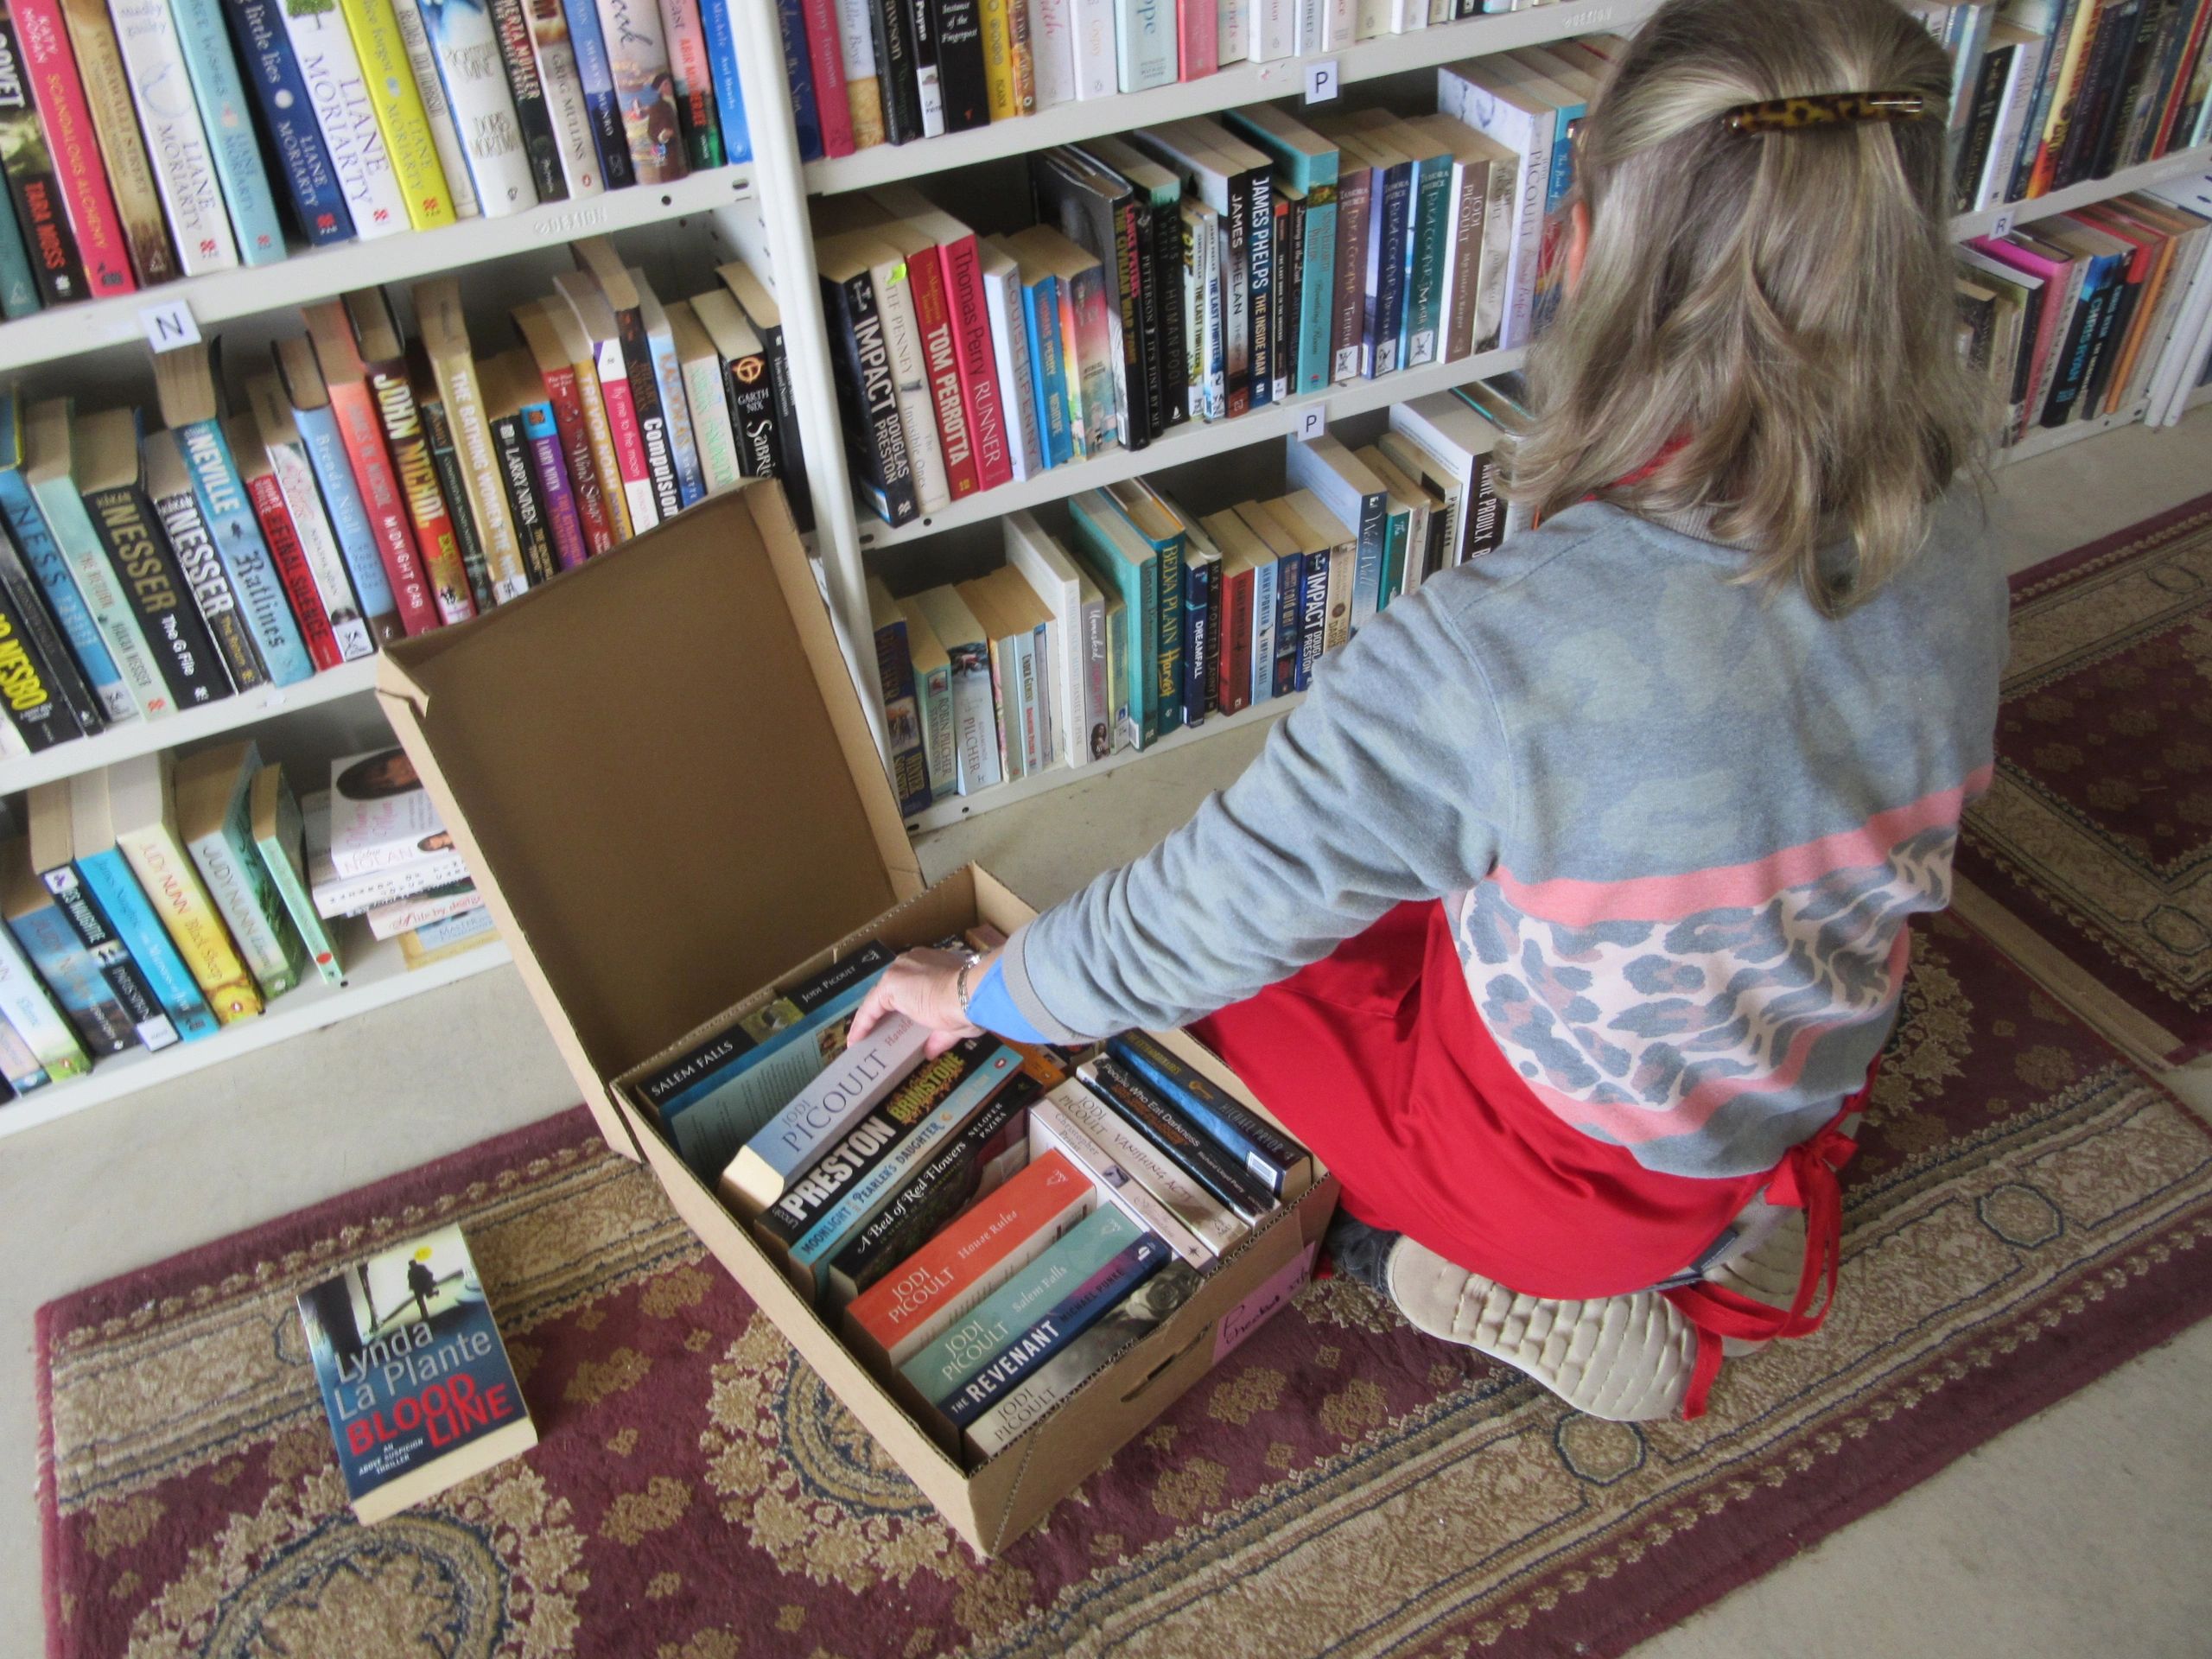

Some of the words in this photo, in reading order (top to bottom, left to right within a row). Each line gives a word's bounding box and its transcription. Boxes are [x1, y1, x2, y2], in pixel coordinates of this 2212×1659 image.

[244, 5, 275, 50] little
[260, 51, 286, 84] lies
[550, 54, 569, 93] GREG
[562, 99, 587, 159] MULLINS
[1315, 72, 1329, 92] P
[304, 56, 372, 204] MORIARTY
[340, 78, 389, 174] LIANE
[597, 92, 613, 135] MUNRO
[157, 125, 202, 232] MORIARTY
[181, 142, 216, 210] LIANE
[277, 122, 318, 207] MORIARTY
[298, 136, 328, 187] LIANE
[23, 181, 53, 221] TARA
[1112, 207, 1126, 234] THE
[1124, 204, 1137, 247] LANCE
[1230, 194, 1243, 247] JAMES
[1252, 177, 1269, 227] JAMES
[1459, 185, 1471, 241] PICOULT
[1470, 195, 1482, 226] JODI
[1115, 236, 1131, 294] CIVILIAN
[1127, 251, 1141, 297] PETERS
[1232, 251, 1245, 314] PHELAN
[1250, 231, 1269, 289] PHELPS
[953, 251, 979, 322] Thomas
[1141, 256, 1154, 321] PETTERSON
[1192, 285, 1204, 304] THE
[1208, 276, 1217, 296] THE
[1209, 297, 1219, 321] LAST
[1253, 293, 1267, 315] THE
[156, 313, 184, 340] N
[1120, 298, 1134, 328] WAR
[1163, 289, 1179, 346] HUMAN
[1193, 305, 1204, 325] LAST
[1253, 316, 1267, 350] INSIDE
[2079, 296, 2103, 343] CHRIS
[854, 317, 894, 411] IMPACT
[890, 316, 912, 374] PENNEY
[925, 324, 953, 371] TOM
[966, 328, 988, 375] Perry
[1042, 341, 1056, 377] PERRY
[1254, 352, 1267, 376] MAN
[2066, 344, 2087, 383] RYAN
[372, 371, 422, 439] JOHN
[449, 372, 471, 402] THE
[457, 404, 489, 469] BATHING
[578, 374, 606, 440] TREVOR
[595, 442, 618, 489] NOAH
[934, 373, 970, 464] PERROTTA
[972, 382, 1001, 466] RUNNER
[1048, 393, 1063, 435] NIGHTLIFE
[1306, 415, 1318, 432] P
[535, 438, 554, 467] LARRY
[570, 444, 594, 484] Wind
[640, 418, 680, 515] Compulsion
[873, 422, 896, 483] PRESTON
[886, 416, 909, 477] DOUGLAS
[903, 406, 923, 454] Invisible
[913, 459, 928, 488] Ones
[922, 434, 934, 452] The
[186, 434, 241, 514] NEVILLE
[314, 433, 346, 490] Brenda
[334, 495, 360, 535] Niall
[395, 441, 445, 528] NICHOL
[504, 448, 528, 490] LARRY
[542, 465, 561, 492] NIVEN
[475, 471, 505, 529] WOMEN
[515, 487, 538, 525] NIVEN
[581, 483, 604, 526] Singer
[1474, 499, 1495, 542] PROULX
[102, 504, 176, 613] NESSER
[165, 508, 234, 617] NESSER
[382, 515, 415, 581] MIDNIGHT
[405, 582, 424, 608] CAB
[1161, 545, 1178, 593] BELVA
[1208, 565, 1221, 592] MAX
[233, 552, 289, 646] Ratlines
[1162, 596, 1178, 644] PLAIN
[1305, 572, 1325, 629] IMPACT
[160, 613, 182, 640] The
[170, 638, 188, 652] G
[1192, 620, 1204, 677] DREAMFALL
[176, 652, 198, 677] File
[1158, 649, 1180, 696] Harvest
[1300, 632, 1313, 673] PRESTON
[938, 696, 950, 730] ROBIN
[939, 733, 953, 776] PILCHER
[963, 717, 980, 772] PILCHER
[138, 840, 170, 874] JUDY
[157, 874, 191, 915] NUNN
[200, 844, 236, 890] JUDY
[223, 888, 261, 937] NUNN
[111, 965, 139, 995] PARIS
[651, 1063, 695, 1097] SALEM
[695, 1039, 734, 1069] FALLS
[781, 1097, 812, 1128] JODI
[784, 1049, 887, 1153] PICOULT
[967, 1101, 1004, 1138] NELOFER
[979, 1110, 1007, 1139] PAZIRA
[1058, 1093, 1108, 1138] PICOULT
[1077, 1093, 1107, 1122] JODI
[1099, 1062, 1131, 1093] People
[1127, 1084, 1150, 1105] Who
[1146, 1100, 1165, 1118] Eat
[1161, 1112, 1202, 1148] Darkness
[782, 1111, 894, 1223] PRESTON
[890, 1051, 963, 1121] BRIMSTONE
[1218, 1100, 1256, 1134] MICHAEL
[1251, 1125, 1285, 1154] PRYOR
[801, 1205, 852, 1255] MOONLIGHT
[852, 1158, 898, 1205] PEARLER'S
[895, 1118, 944, 1166] DAUGHTER
[866, 1206, 895, 1240] Bed
[889, 1196, 906, 1217] of
[899, 1173, 930, 1207] Red
[922, 1138, 968, 1184] Flowers
[888, 1268, 957, 1324] PICOULT
[957, 1229, 993, 1260] House
[988, 1205, 1020, 1235] Rules
[891, 1264, 931, 1303] JODI
[942, 1319, 1010, 1382] PICOULT
[1011, 1281, 1045, 1314] Salem
[1040, 1261, 1069, 1290] Falls
[945, 1319, 985, 1358] JODI
[950, 1395, 970, 1414] THE
[967, 1319, 1059, 1403] REVENANT
[1058, 1289, 1098, 1323] MICHAEL
[1095, 1267, 1127, 1295] PUNKE
[334, 1381, 375, 1421] La
[386, 1329, 491, 1395] Plante
[335, 1320, 433, 1385] Lynda
[349, 1372, 475, 1455] BLOOD
[427, 1382, 512, 1447] LINE
[994, 1388, 1058, 1444] PICOULT
[995, 1386, 1037, 1423] JODI
[359, 1459, 382, 1476] ABOVE
[384, 1437, 424, 1464] SUSPICION
[376, 1454, 410, 1474] THRILLER
[382, 1442, 395, 1452] AN
